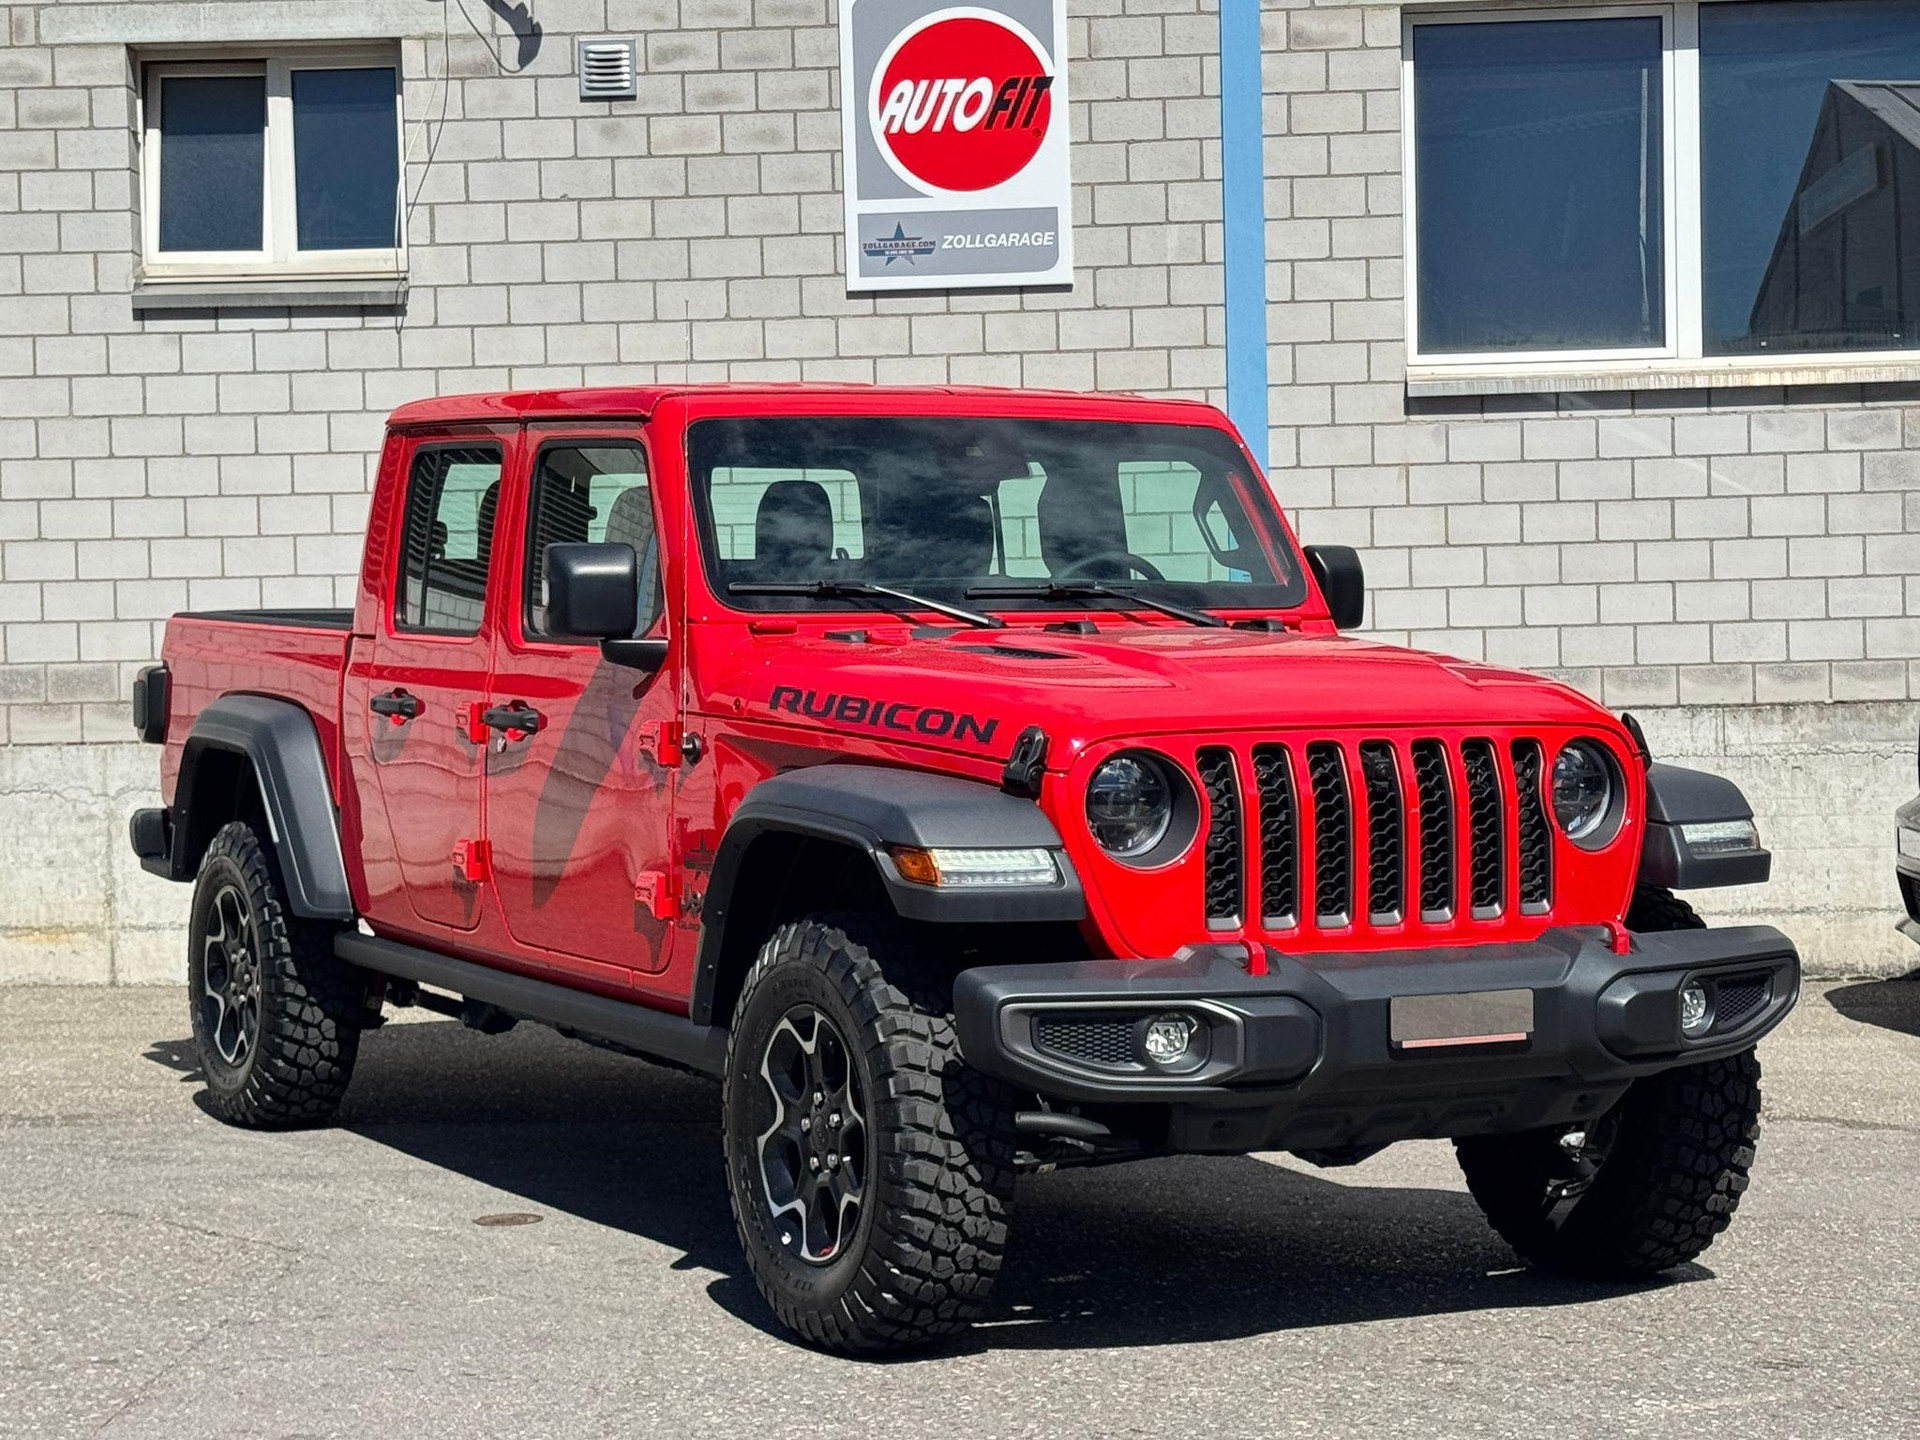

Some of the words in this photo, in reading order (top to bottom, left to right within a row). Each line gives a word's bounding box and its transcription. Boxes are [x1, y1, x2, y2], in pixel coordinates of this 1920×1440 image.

[880, 76, 1055, 134] AUTOFIT
[942, 232, 1055, 249] ZOLLGARAGE
[769, 685, 999, 744] RUBICON
